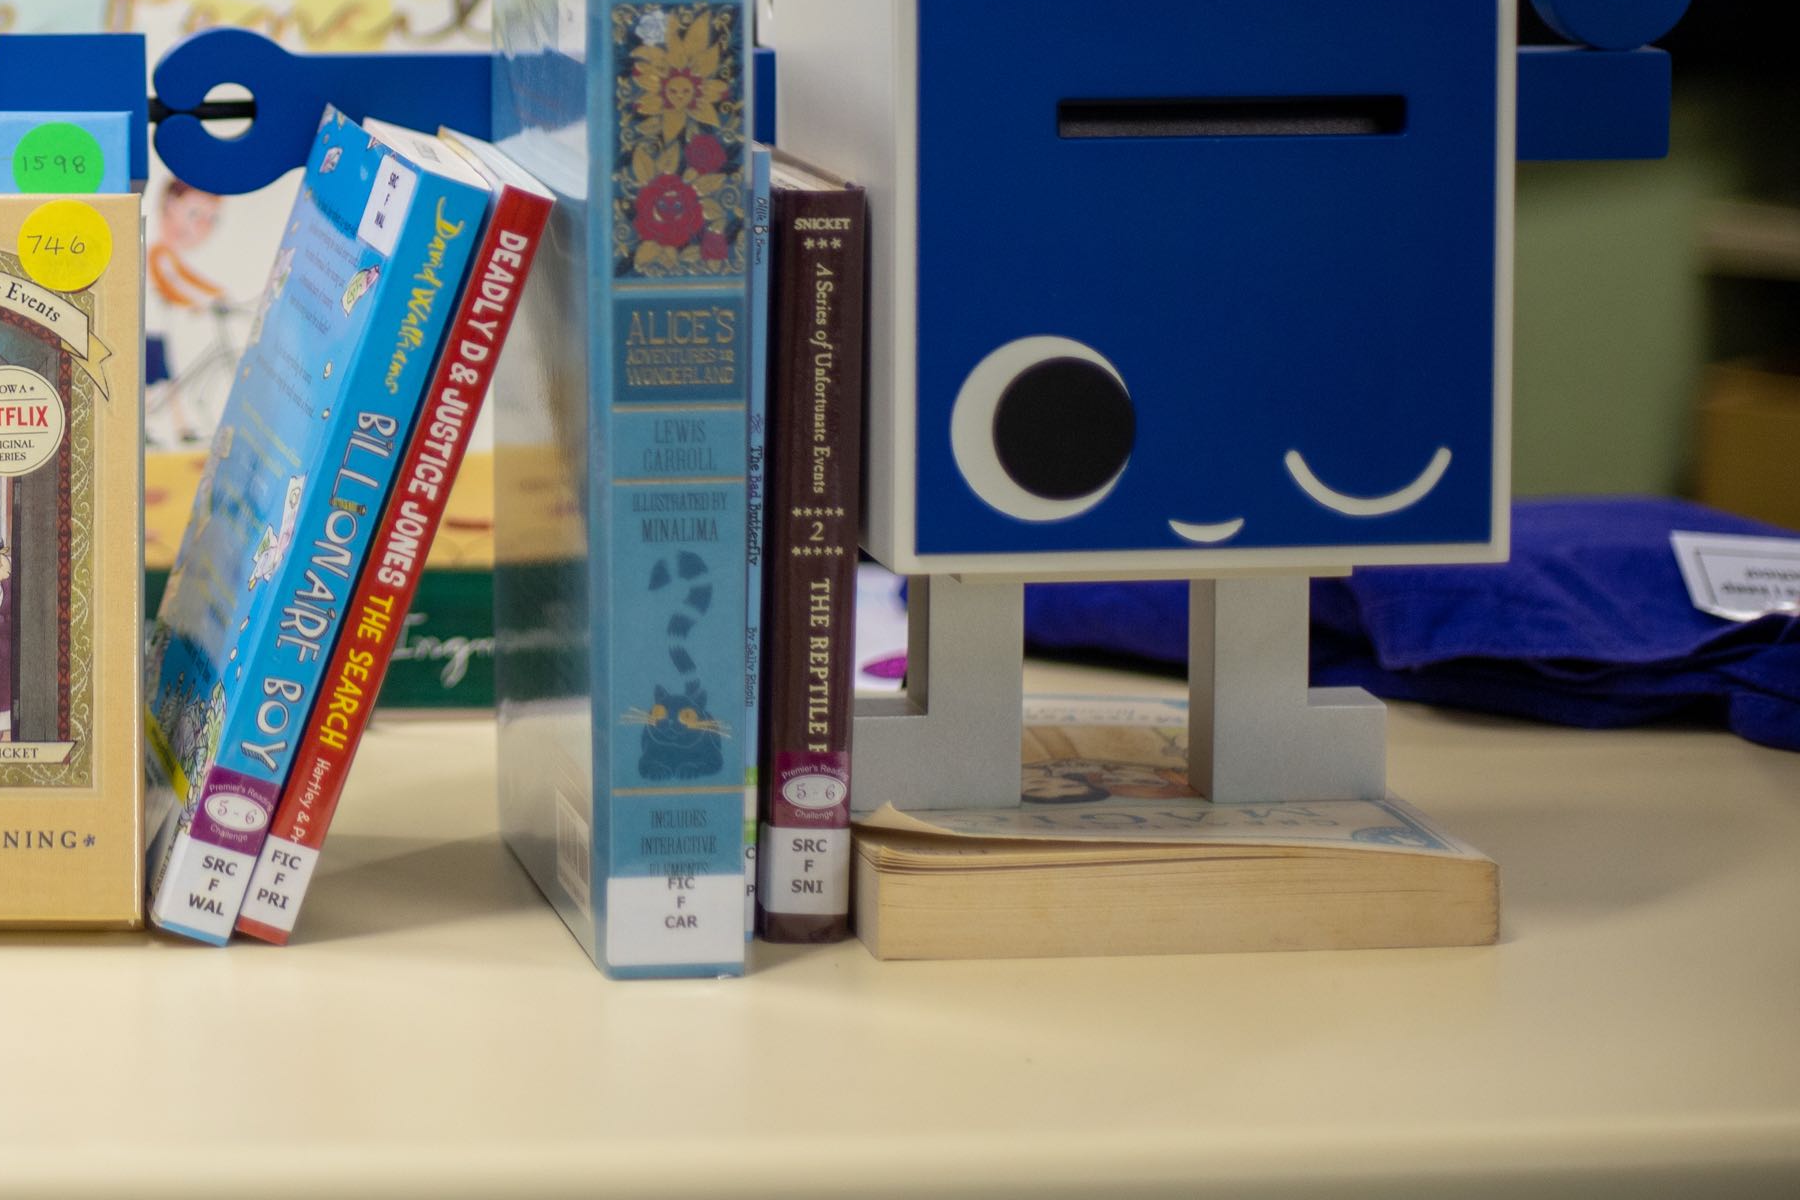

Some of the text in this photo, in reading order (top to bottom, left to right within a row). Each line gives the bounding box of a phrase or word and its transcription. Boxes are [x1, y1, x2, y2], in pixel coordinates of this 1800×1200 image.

[21, 155, 87, 176] 1598
[793, 217, 852, 230] SNICKET
[27, 234, 87, 256] 746
[413, 196, 465, 283] David
[6, 281, 62, 324] Events
[626, 306, 736, 346] ALICE'S
[383, 280, 438, 396] Walliams
[626, 348, 718, 365] ADVENTURES
[626, 366, 735, 386] WONDERLAND
[808, 262, 834, 495] A Series of Unfortunate Events
[654, 419, 706, 444] LEWIS
[642, 448, 718, 473] CARROLL
[318, 230, 529, 750] DEADLY D & JUSTICE JONES THE SEARCH
[632, 492, 728, 513] ILLUSTRATED BY
[747, 445, 763, 566] The Bad Butterfly
[275, 411, 399, 664] BILLIONAIRE
[642, 518, 719, 544] MINALIMA
[810, 522, 824, 541] 2
[810, 578, 830, 628] THE
[808, 636, 829, 736] REPTILE
[240, 674, 306, 774] BOY
[782, 765, 819, 780] Premier's
[209, 784, 274, 812] Premier's Reading
[297, 757, 331, 824] Hartley &
[796, 783, 836, 800] 5 6
[218, 800, 258, 825] 5 6
[649, 809, 708, 829] INCLUDES
[794, 808, 834, 820] Challenge
[210, 823, 248, 842] Challenge
[640, 834, 718, 856] INTERACTIVE
[792, 838, 828, 852] SRC
[202, 855, 238, 876] SRC
[271, 850, 302, 870] FIC
[804, 860, 814, 872] F
[208, 878, 220, 892] F
[274, 872, 286, 886] F
[668, 876, 696, 890] FIC
[791, 879, 824, 894] SNI
[188, 892, 225, 916] WAL
[256, 888, 290, 910] PRI
[676, 895, 686, 909] F
[664, 915, 698, 929] CAR
